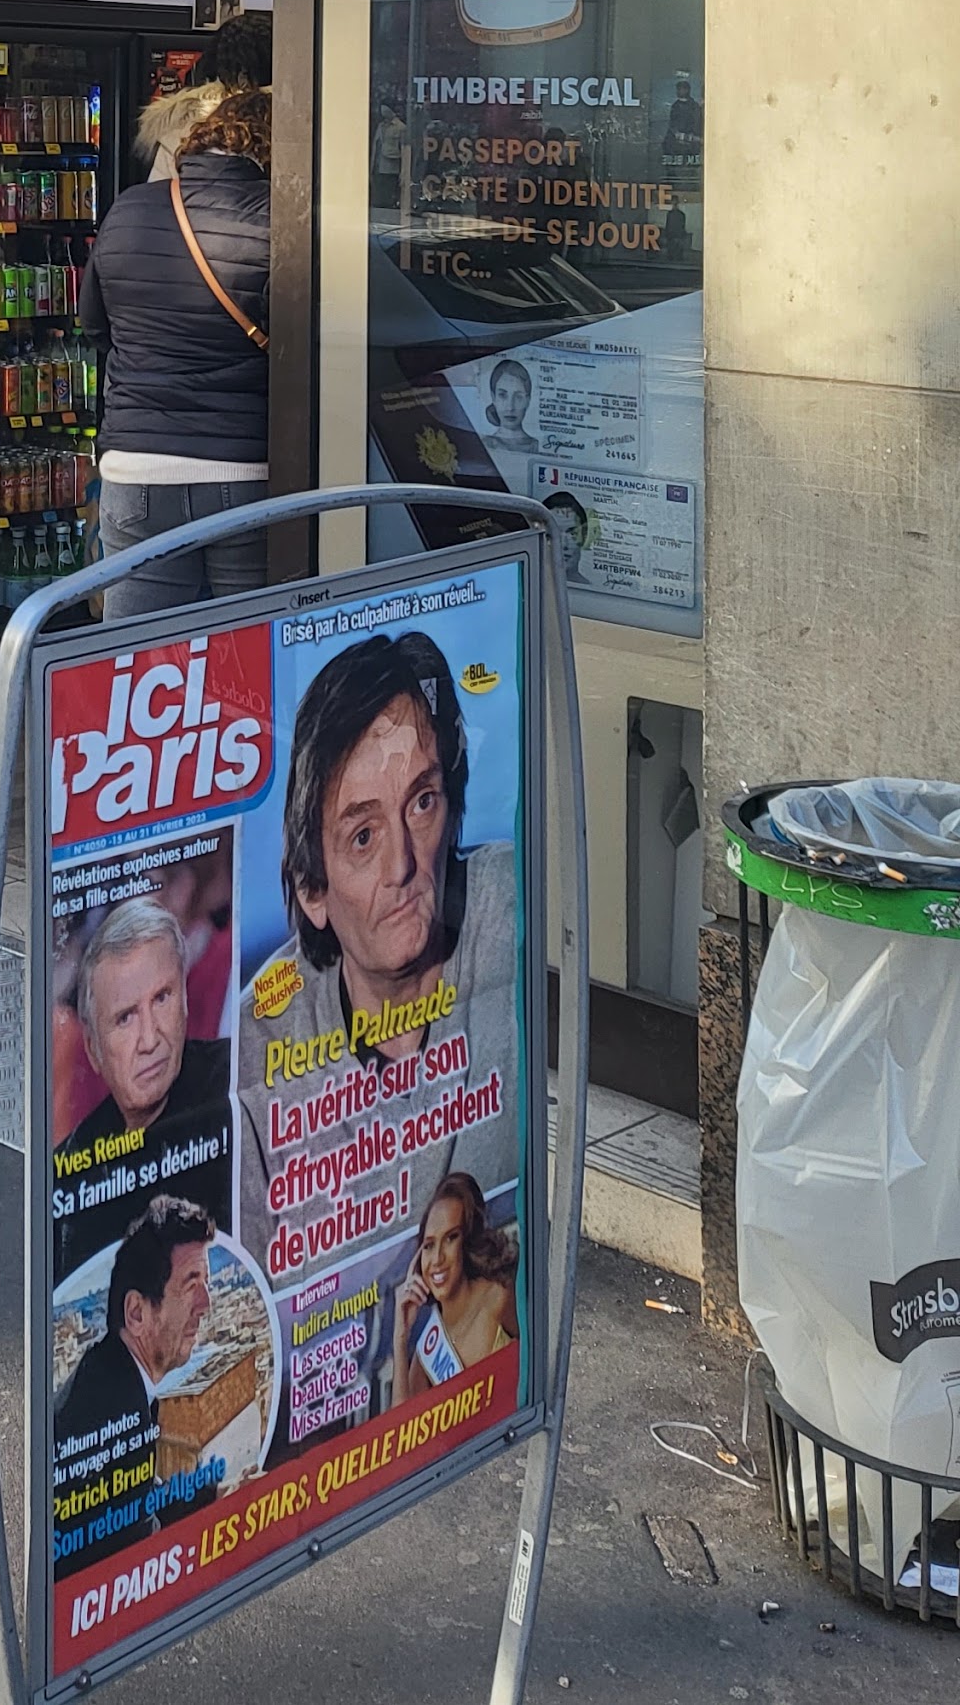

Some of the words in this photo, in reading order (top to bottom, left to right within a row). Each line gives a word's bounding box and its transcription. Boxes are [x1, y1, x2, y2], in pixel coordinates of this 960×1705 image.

[413, 76, 526, 105] TIMBRE
[532, 77, 641, 107] FISCAL
[423, 137, 581, 167] PASSEPORT
[421, 173, 508, 204] CARTE
[518, 176, 674, 210] D'IDENTITE
[502, 216, 537, 243] DE
[546, 218, 662, 252] SEJOUR
[422, 249, 492, 280] ETC...
[594, 434, 636, 448] SPÉCIMEN
[564, 472, 611, 486] RÉPUBLIQUE
[614, 479, 660, 493] FRANÇAISE
[282, 618, 315, 646] Brisé
[315, 620, 338, 644] par
[338, 611, 350, 634] la
[350, 593, 412, 632] culpabilité
[412, 591, 421, 615] à
[421, 592, 443, 614] son
[443, 581, 486, 607] réveil...
[297, 589, 332, 609] Insert
[107, 635, 209, 746] ici
[50, 701, 262, 836] Paris
[124, 831, 139, 844] AU
[152, 818, 184, 836] FÉVRIER
[185, 812, 208, 828] 2023
[52, 861, 122, 895] Révélations
[123, 847, 182, 880] explosives
[182, 836, 221, 860] autour
[52, 897, 68, 919] de
[70, 897, 84, 915] sa
[86, 886, 108, 910] fille
[109, 876, 163, 903] cachée...
[255, 976, 275, 998] Nos
[255, 977, 303, 1017] exclusives
[265, 1036, 343, 1089] Pierre
[349, 978, 458, 1058] Palmade
[271, 1099, 306, 1152] La
[305, 1072, 378, 1137] vérité
[382, 1060, 420, 1099] sur
[423, 1035, 470, 1082] son
[52, 1141, 93, 1180] Yves
[94, 1126, 147, 1168] Rénier
[268, 1137, 397, 1213] effroyable
[401, 1072, 502, 1156] accident
[52, 1188, 76, 1221] Sa
[77, 1165, 137, 1213] famille
[139, 1163, 159, 1188] se
[160, 1135, 220, 1179] déchire
[222, 1126, 229, 1156] !
[269, 1231, 306, 1281] de
[305, 1188, 395, 1263] voiture
[398, 1170, 410, 1217] !
[293, 1310, 330, 1346] Indira
[331, 1279, 381, 1326] Ampiot
[295, 1275, 339, 1313] Interview
[292, 1353, 313, 1380] Les
[315, 1324, 366, 1367] secrets
[291, 1364, 338, 1410] beauté
[340, 1357, 357, 1384] de
[52, 1430, 99, 1464] L'album
[99, 1410, 141, 1446] photos
[291, 1411, 322, 1442] Miss
[324, 1384, 369, 1423] France
[52, 1465, 68, 1489] du
[68, 1449, 111, 1480] voyage
[112, 1440, 128, 1460] de
[128, 1435, 143, 1453] sa
[143, 1422, 161, 1444] vie
[53, 1475, 110, 1523] Patrick
[112, 1451, 155, 1497] Bruel
[54, 1525, 84, 1564] Son
[88, 1496, 143, 1546] retour
[145, 1486, 168, 1517] en
[168, 1453, 227, 1503] Algérie
[70, 1589, 108, 1639] ICI
[110, 1550, 184, 1617] PARIS
[199, 1511, 242, 1570] LES
[316, 1435, 395, 1505] QUELLE
[395, 1380, 485, 1462] HISTOIRE
